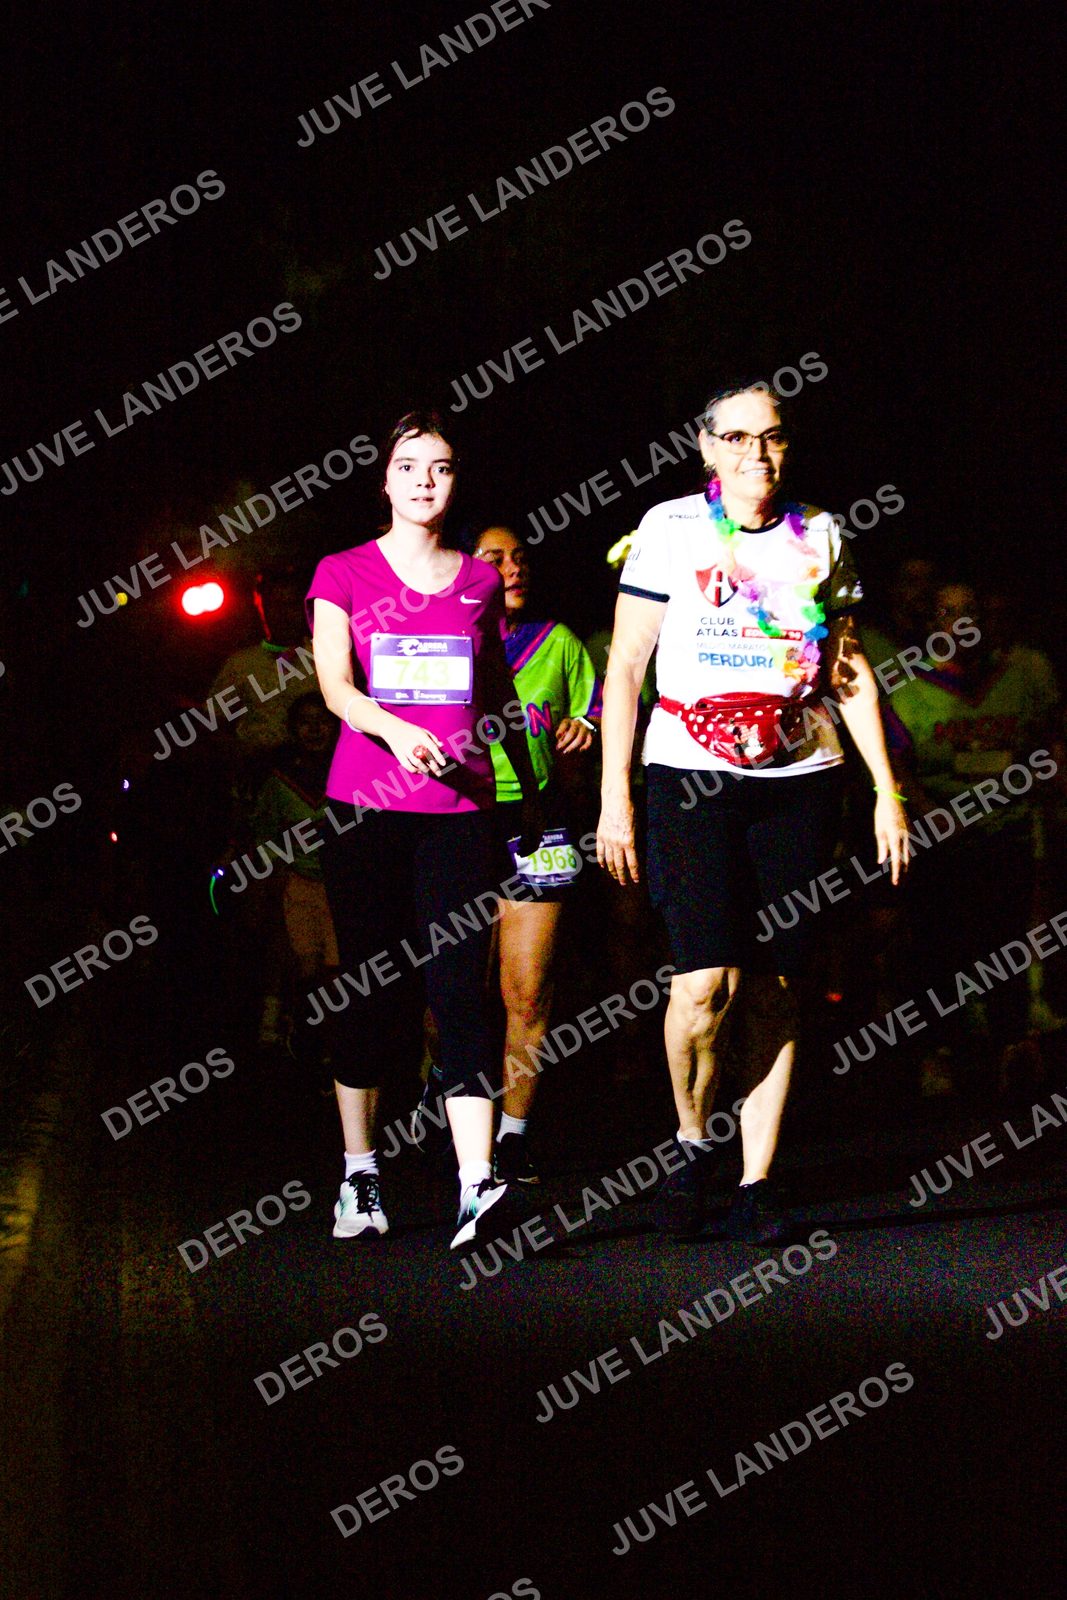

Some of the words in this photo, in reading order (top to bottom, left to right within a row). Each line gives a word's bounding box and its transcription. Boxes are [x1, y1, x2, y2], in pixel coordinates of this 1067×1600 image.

[700, 617, 735, 625] CLUB
[696, 628, 738, 637] ATLAS
[394, 659, 449, 687] 743
